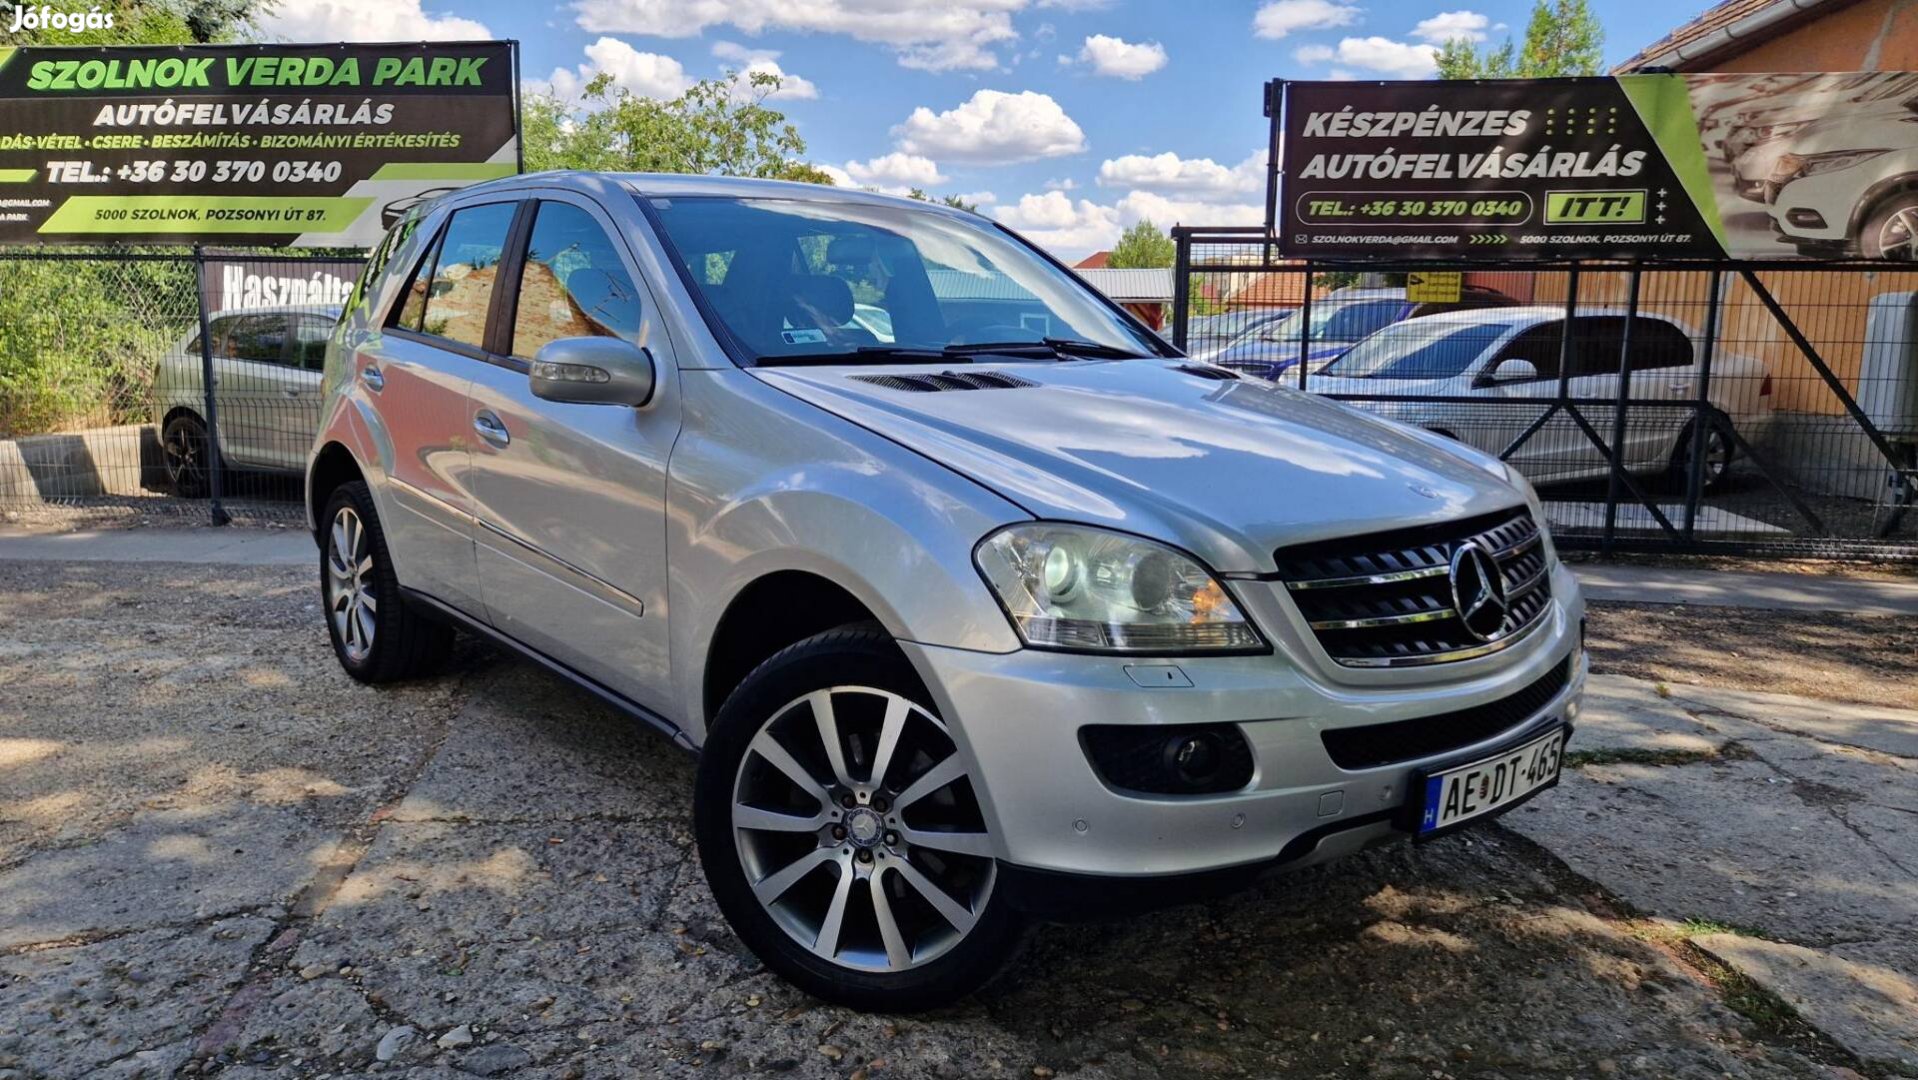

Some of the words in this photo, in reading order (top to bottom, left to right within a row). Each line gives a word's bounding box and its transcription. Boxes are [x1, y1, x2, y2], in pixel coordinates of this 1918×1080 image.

[26, 58, 215, 90] SZOLNOK
[226, 57, 361, 86] VERDA
[372, 56, 489, 86] PARK
[93, 98, 395, 126] AUTÓFELVÁSÁRLÁS
[1303, 104, 1532, 138] KÉSZPÉNZES
[92, 135, 143, 150] CSERE
[151, 132, 251, 149] BESZÁMÍTÁS
[260, 131, 350, 148] BIZOMÁNYI
[353, 131, 461, 148] ÉRTÉKESÍTÉS
[46, 161, 111, 183] TEL.:
[117, 161, 167, 183] +36
[170, 160, 207, 183] 30
[212, 160, 266, 183] 370
[272, 160, 342, 183] 0340
[1299, 144, 1648, 180] AUTÓFELVÁSÁRLÁS
[0, 199, 50, 208] @GMAIL.COM
[1308, 201, 1355, 217] TEL.:
[1361, 201, 1397, 217] +36
[1398, 201, 1426, 216] 30
[1428, 201, 1468, 216] 370
[1471, 201, 1522, 216] 0340
[1560, 196, 1632, 218] ITT!
[6, 213, 28, 221] PARK
[94, 209, 128, 221] 5000
[131, 209, 201, 222] SZOLNOK,
[205, 209, 281, 221] POZSONYI
[284, 206, 305, 221] ÚT
[306, 209, 327, 221] 87.
[1312, 235, 1459, 246] SZOLNOKVERDA@GMAIL.COM
[1520, 235, 1548, 244] 5000
[1550, 234, 1600, 244] SZOLNOK,
[1603, 234, 1658, 244] POZSONYI
[1660, 232, 1675, 243] ÚT
[1424, 808, 1434, 825] H
[1443, 771, 1481, 821] AE
